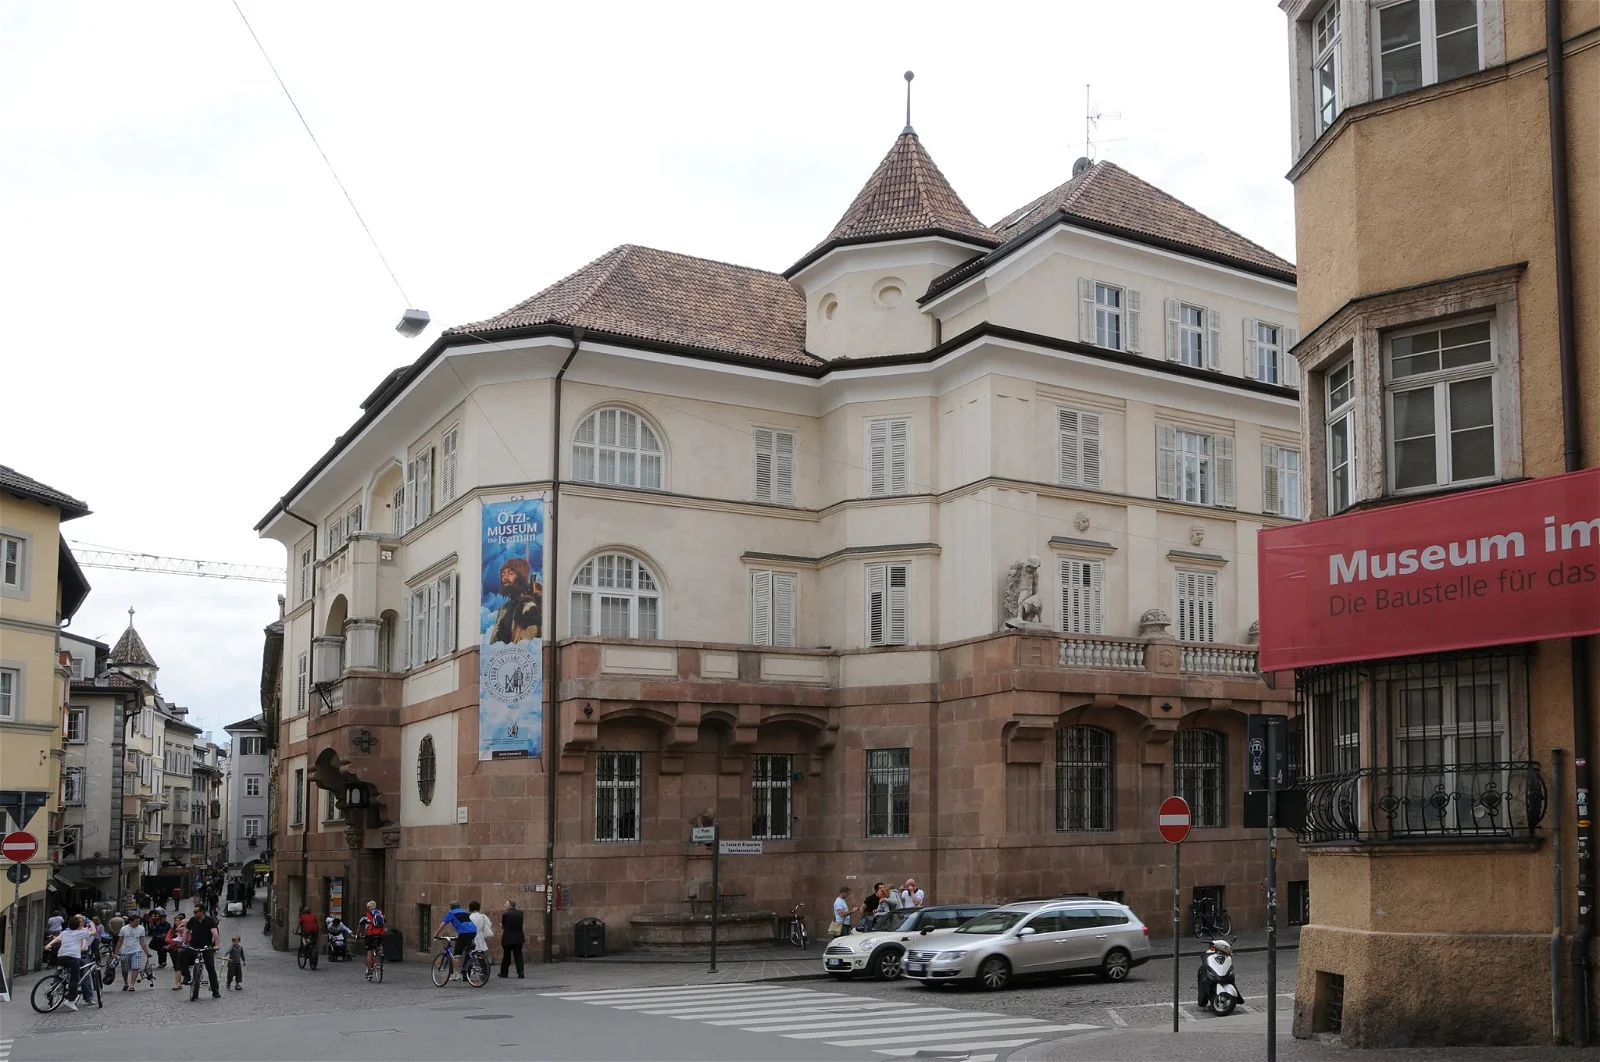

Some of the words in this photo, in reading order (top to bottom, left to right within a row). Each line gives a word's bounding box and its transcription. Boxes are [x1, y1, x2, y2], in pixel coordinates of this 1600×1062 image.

[497, 509, 530, 525] ÖTZI-
[487, 523, 537, 536] MUSEUM
[498, 534, 536, 544] Iceman
[1329, 530, 1525, 586] Museum
[1544, 515, 1600, 553] im
[1330, 592, 1367, 616] Die
[1376, 574, 1488, 611] Baustelle
[1497, 568, 1537, 594] für
[1547, 560, 1597, 587] das
